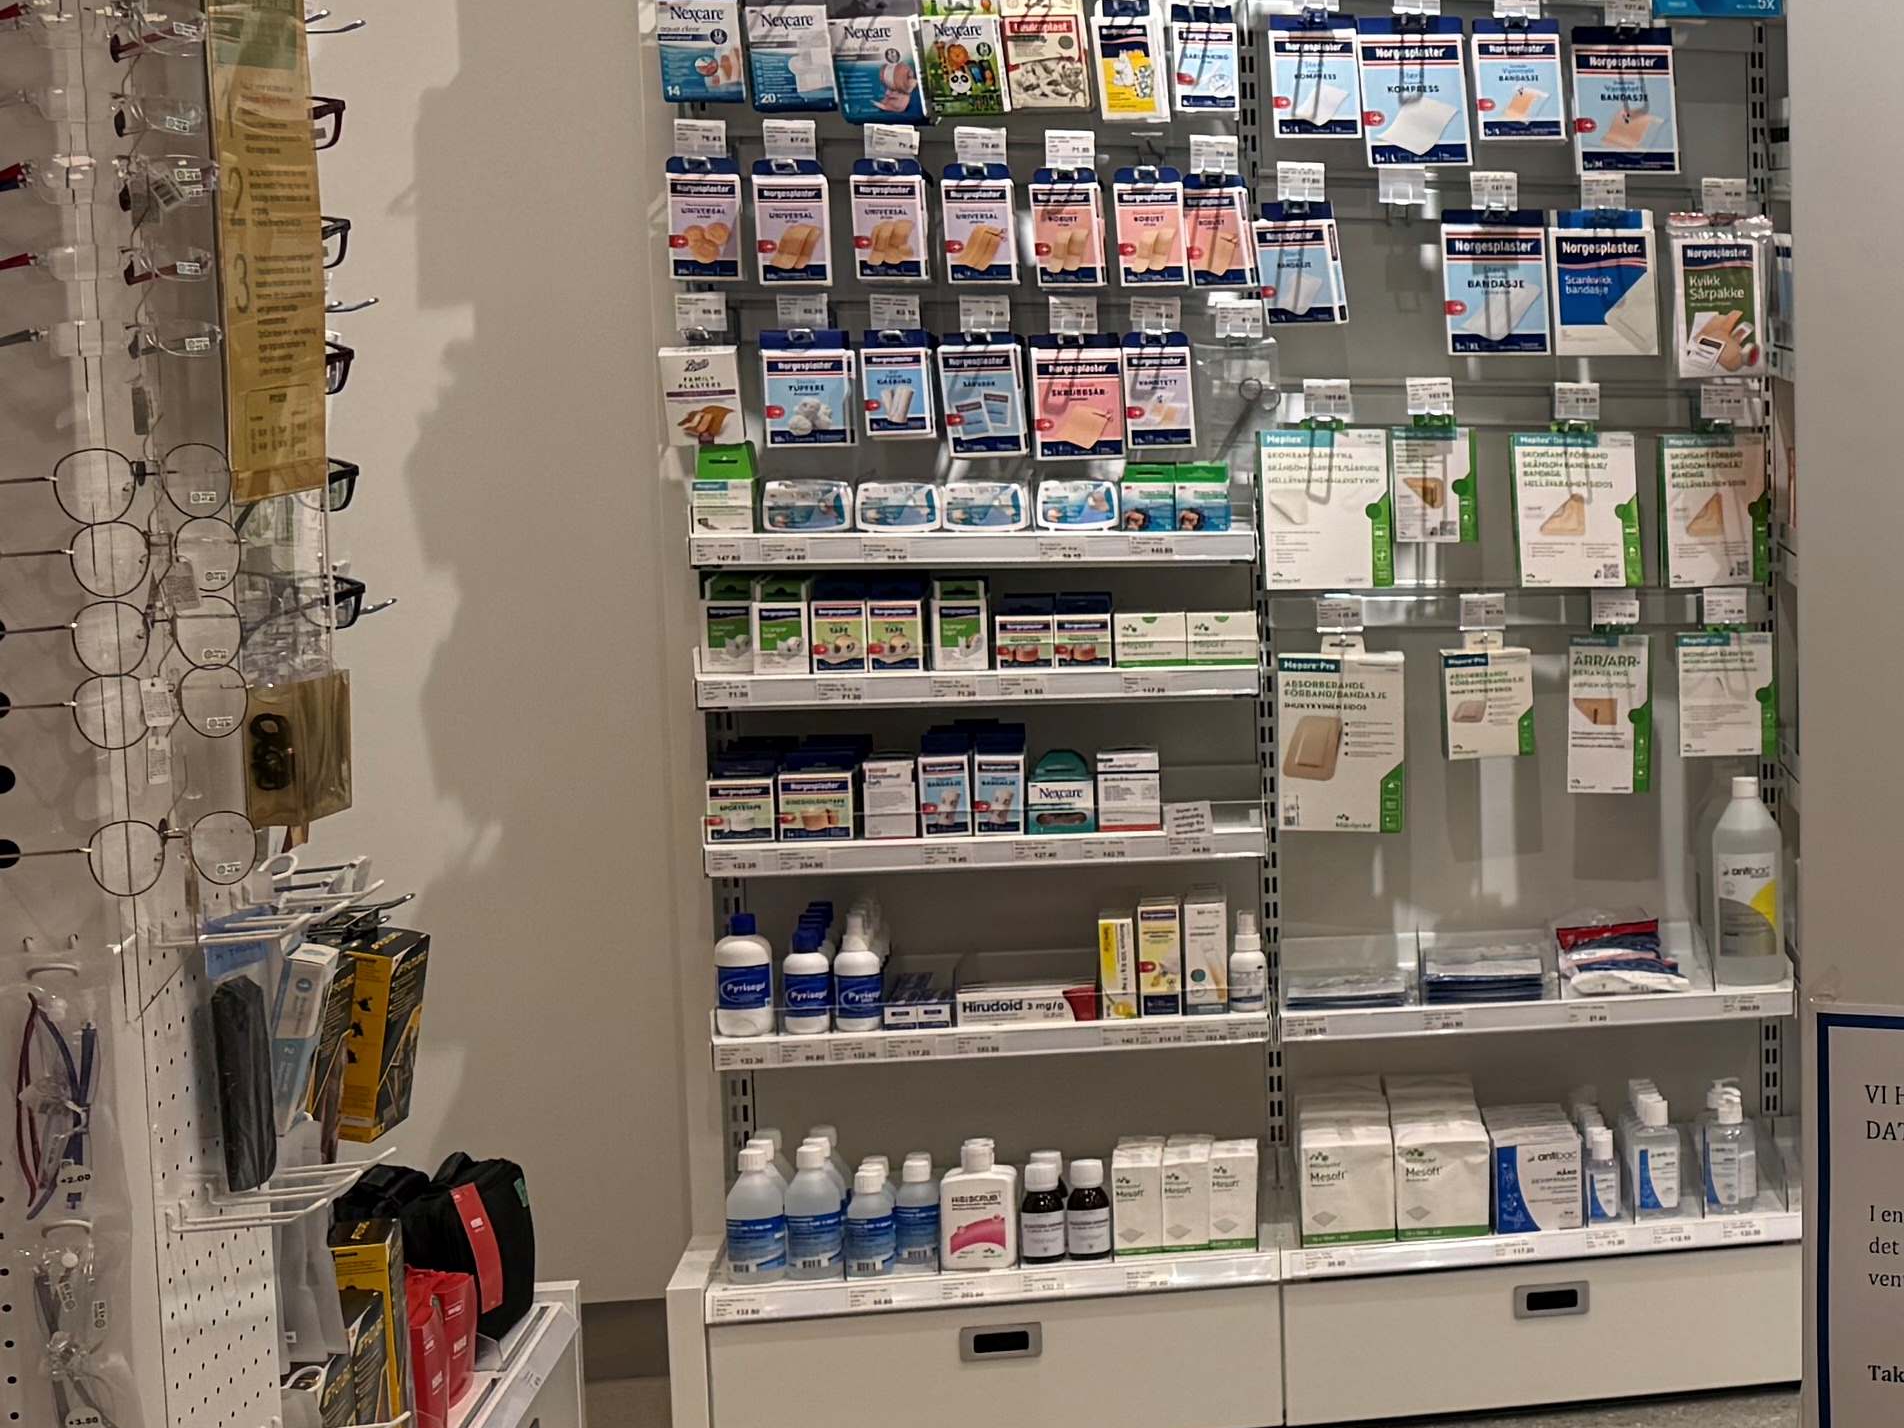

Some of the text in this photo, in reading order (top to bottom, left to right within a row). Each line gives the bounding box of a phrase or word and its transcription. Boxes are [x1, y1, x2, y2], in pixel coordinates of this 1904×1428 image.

[671, 7, 723, 22] Nexcare
[761, 14, 813, 29] Nexcare
[844, 25, 890, 39] Nexcare
[934, 23, 982, 37] Nexcare
[667, 85, 680, 96] 14
[1455, 240, 1533, 254] Norgesplaster
[1562, 241, 1639, 256] Norgesplaster
[1039, 787, 1083, 801] Nexcare
[962, 1000, 1023, 1013] Hirudoid
[1865, 1084, 1887, 1105] VI
[1869, 1205, 1876, 1223] I
[1881, 1209, 1903, 1225] en
[1869, 1237, 1899, 1255] det
